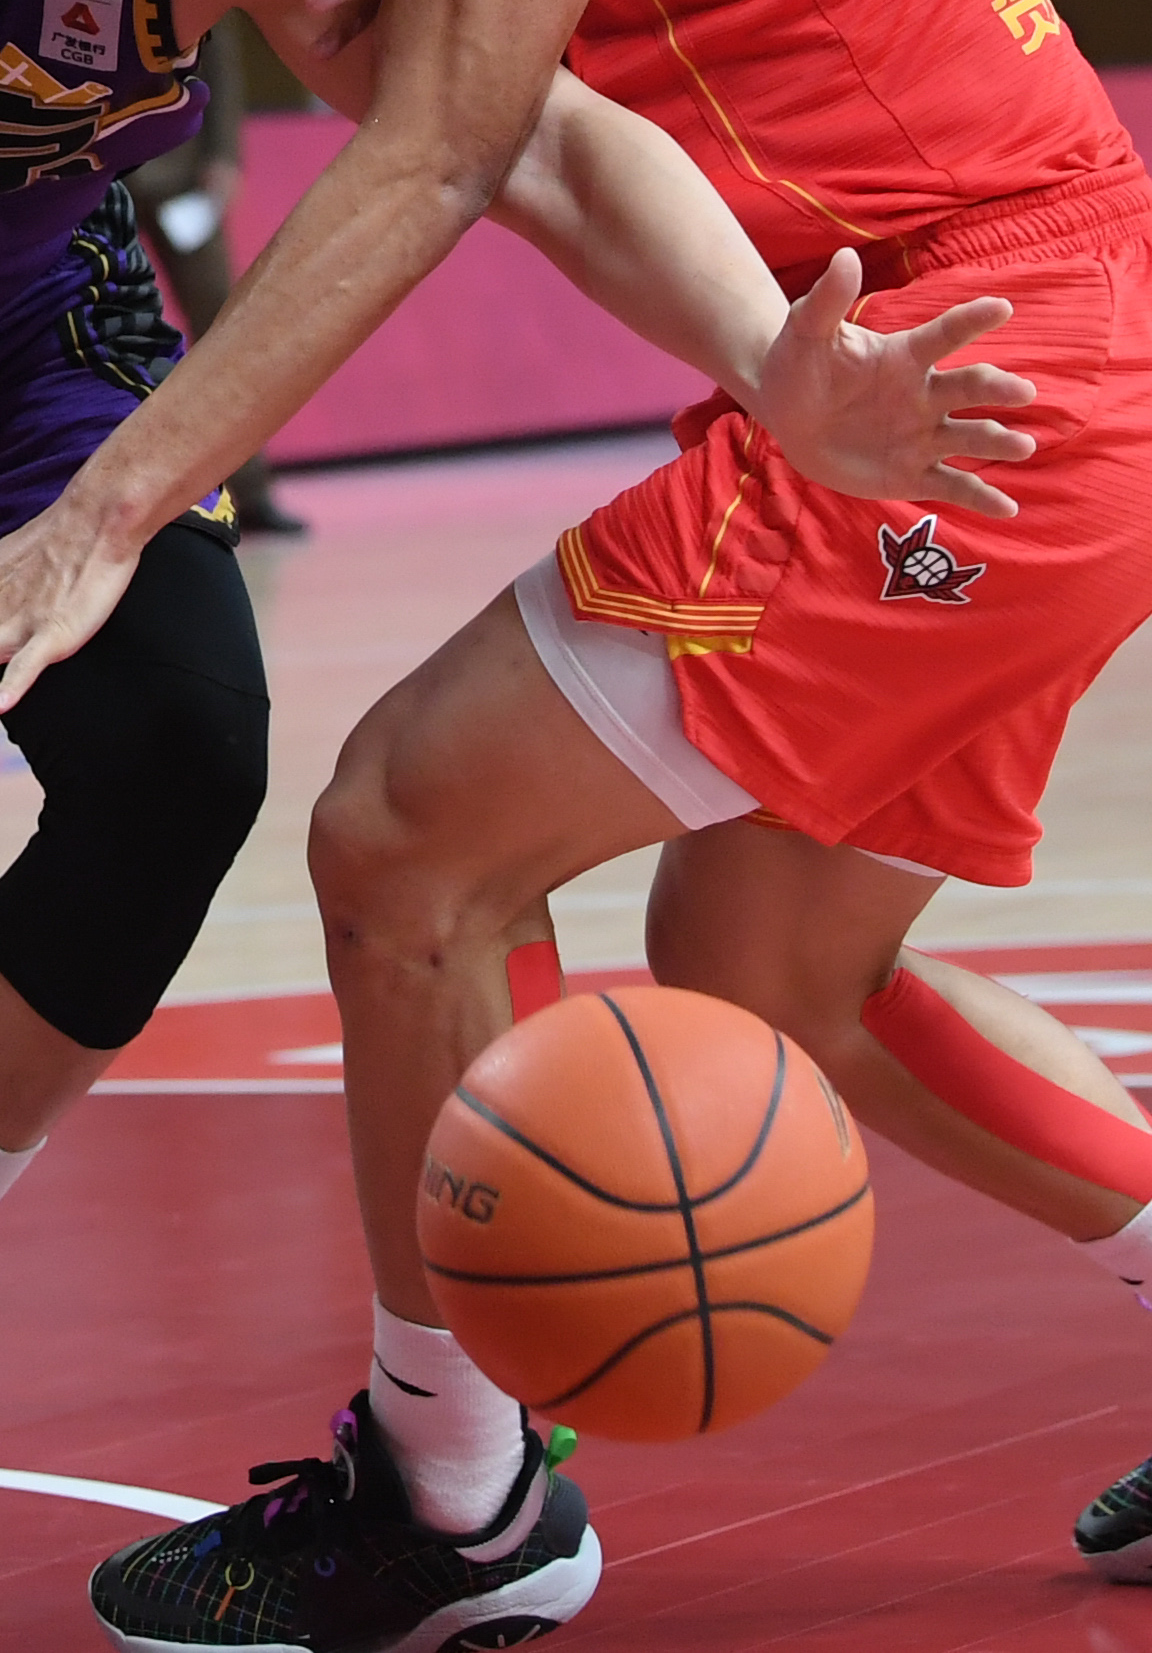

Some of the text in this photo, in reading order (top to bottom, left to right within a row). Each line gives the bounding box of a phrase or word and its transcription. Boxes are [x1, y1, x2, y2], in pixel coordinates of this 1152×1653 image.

[51, 31, 106, 56] 广发银行
[60, 47, 94, 66] CGB
